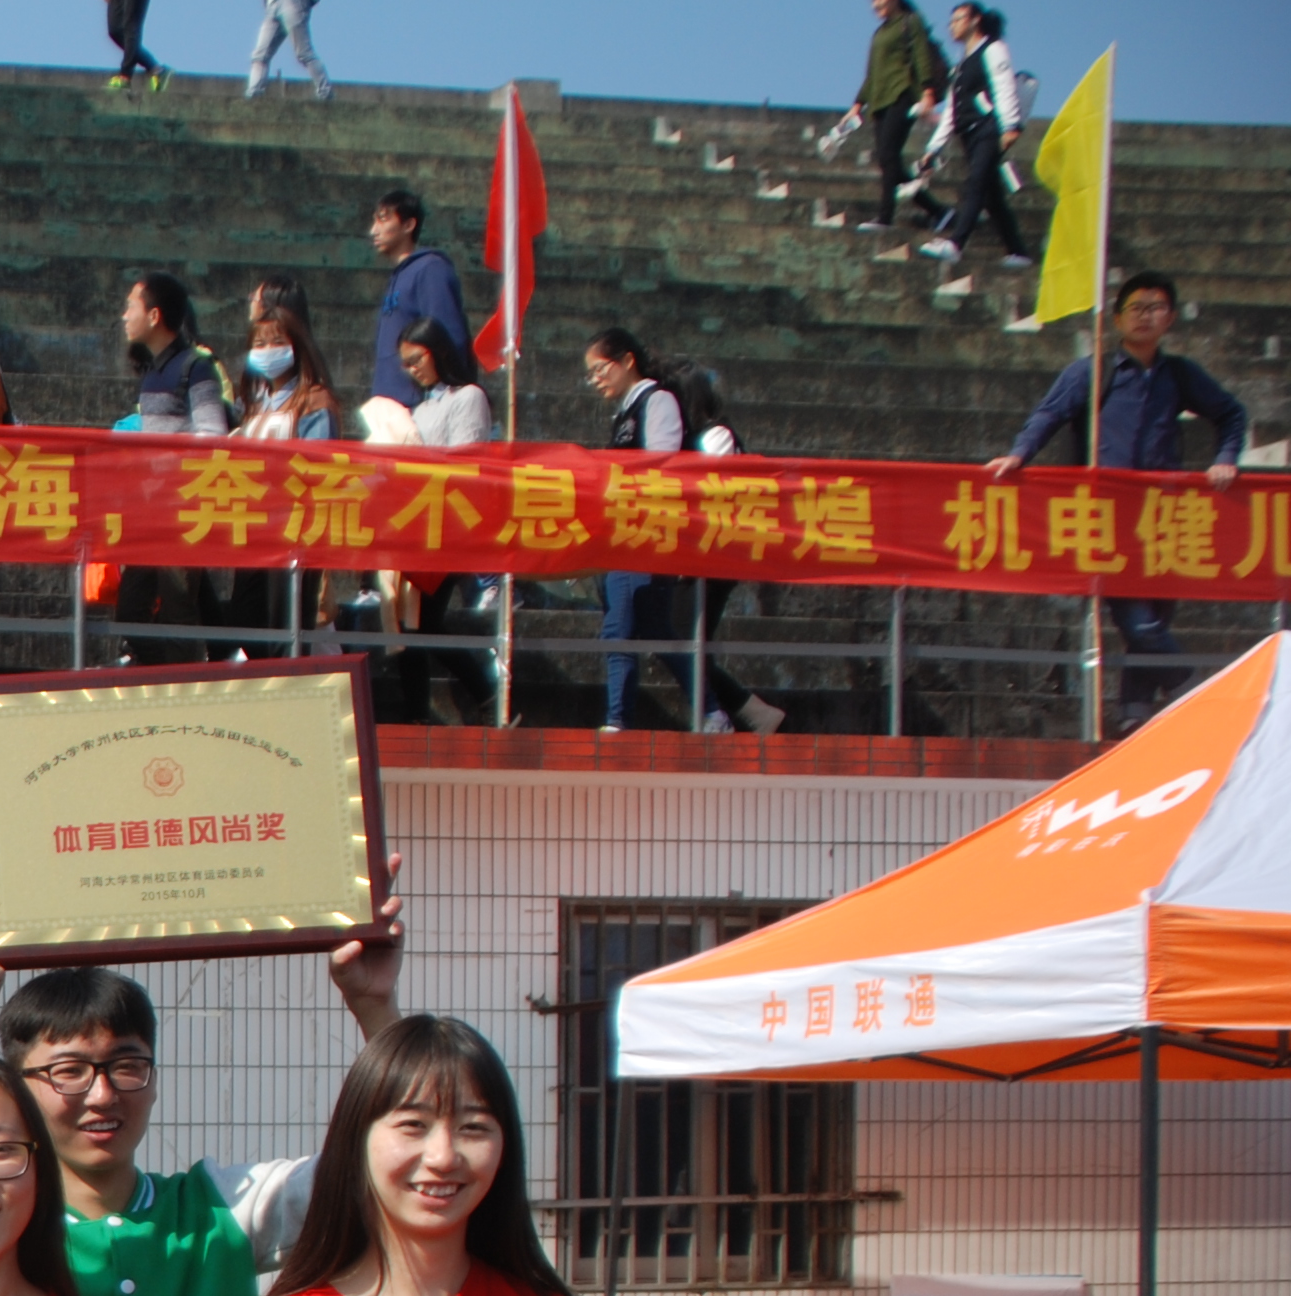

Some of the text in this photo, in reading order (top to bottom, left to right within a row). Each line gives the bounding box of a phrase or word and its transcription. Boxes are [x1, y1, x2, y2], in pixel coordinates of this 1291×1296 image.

[53, 812, 286, 853] 体育道德风尚奖
[79, 867, 265, 888] 河海大学常州校区体育运动委员会
[141, 887, 206, 901] 2015年10月
[760, 973, 937, 1042] 中国联通
